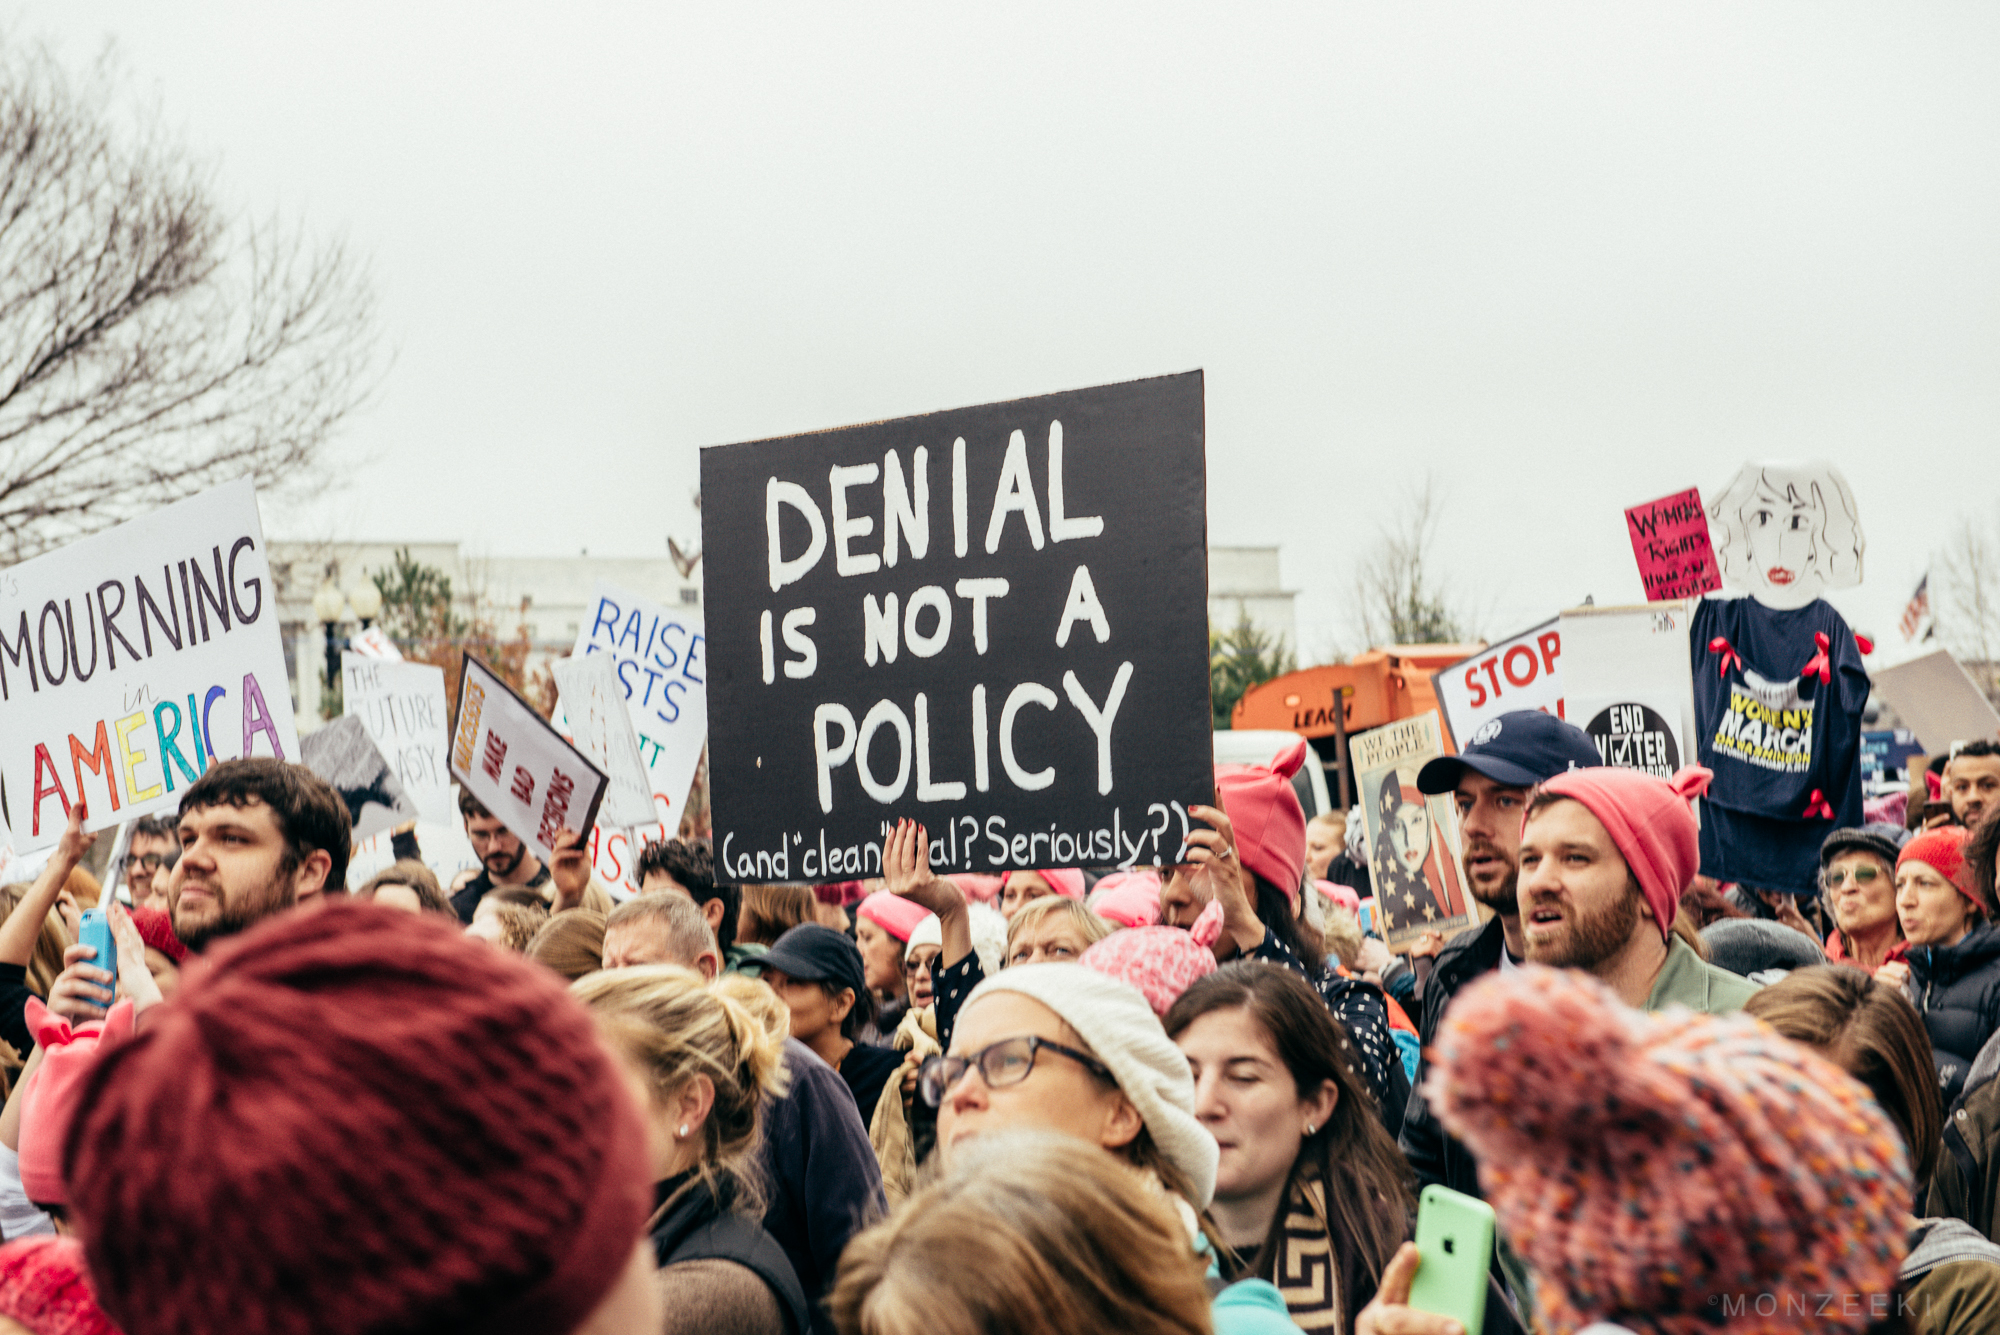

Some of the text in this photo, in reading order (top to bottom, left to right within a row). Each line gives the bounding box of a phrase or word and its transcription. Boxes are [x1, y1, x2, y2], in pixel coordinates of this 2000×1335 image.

[766, 419, 1104, 593] DENIAL
[0, 536, 262, 700] MOURNING
[592, 595, 705, 684] RAISE
[760, 565, 1111, 685] IS NOT A
[124, 683, 159, 713] in
[348, 664, 382, 693] THE
[1465, 630, 1561, 709] STOP
[32, 672, 285, 836] AMERICA
[814, 661, 1133, 814] POLICY
[1363, 722, 1420, 750] WE THE
[1366, 739, 1424, 766] PEOPLE
[1609, 704, 1644, 734] END
[1718, 708, 1812, 754] MARCH
